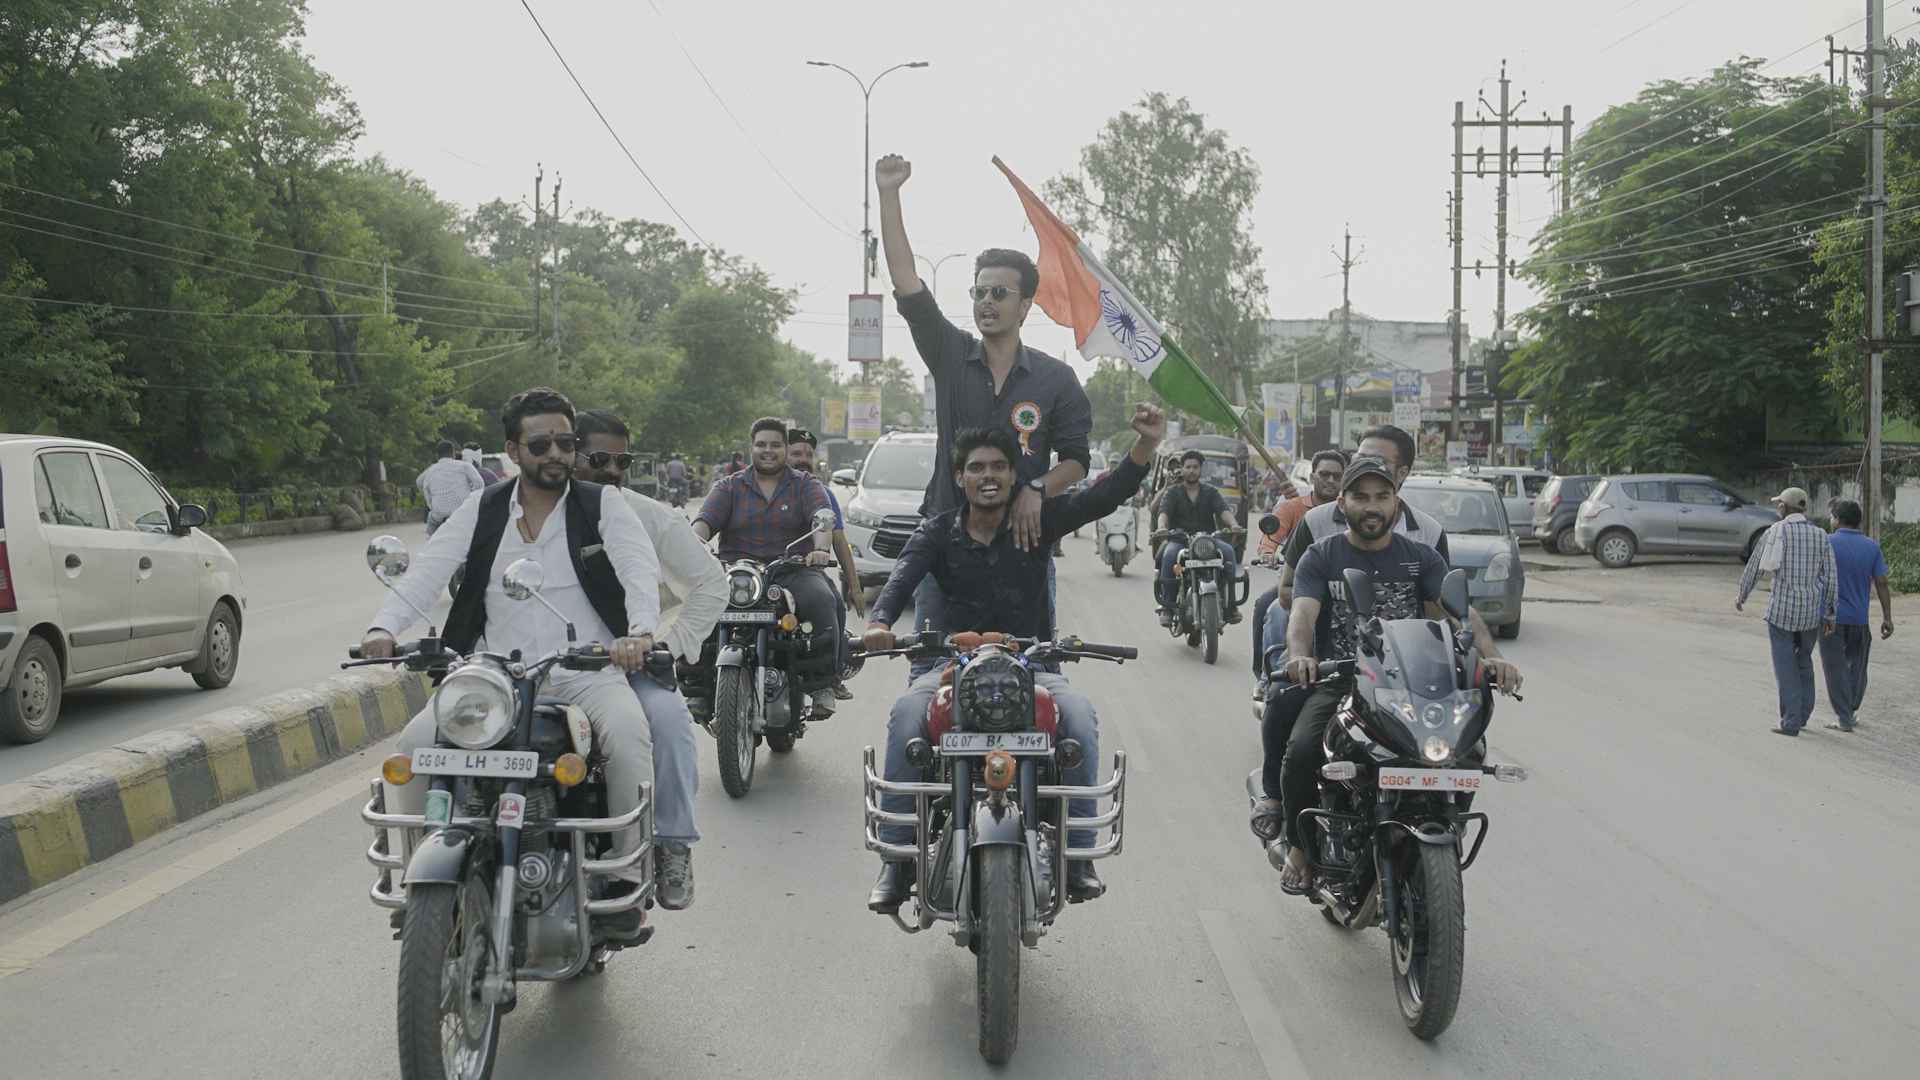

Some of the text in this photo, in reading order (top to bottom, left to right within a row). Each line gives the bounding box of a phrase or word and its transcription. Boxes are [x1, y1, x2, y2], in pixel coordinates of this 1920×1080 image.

[418, 754, 533, 771] CG 04 LH 3690
[1421, 776, 1439, 786] MF
[1454, 777, 1481, 788] 1492
